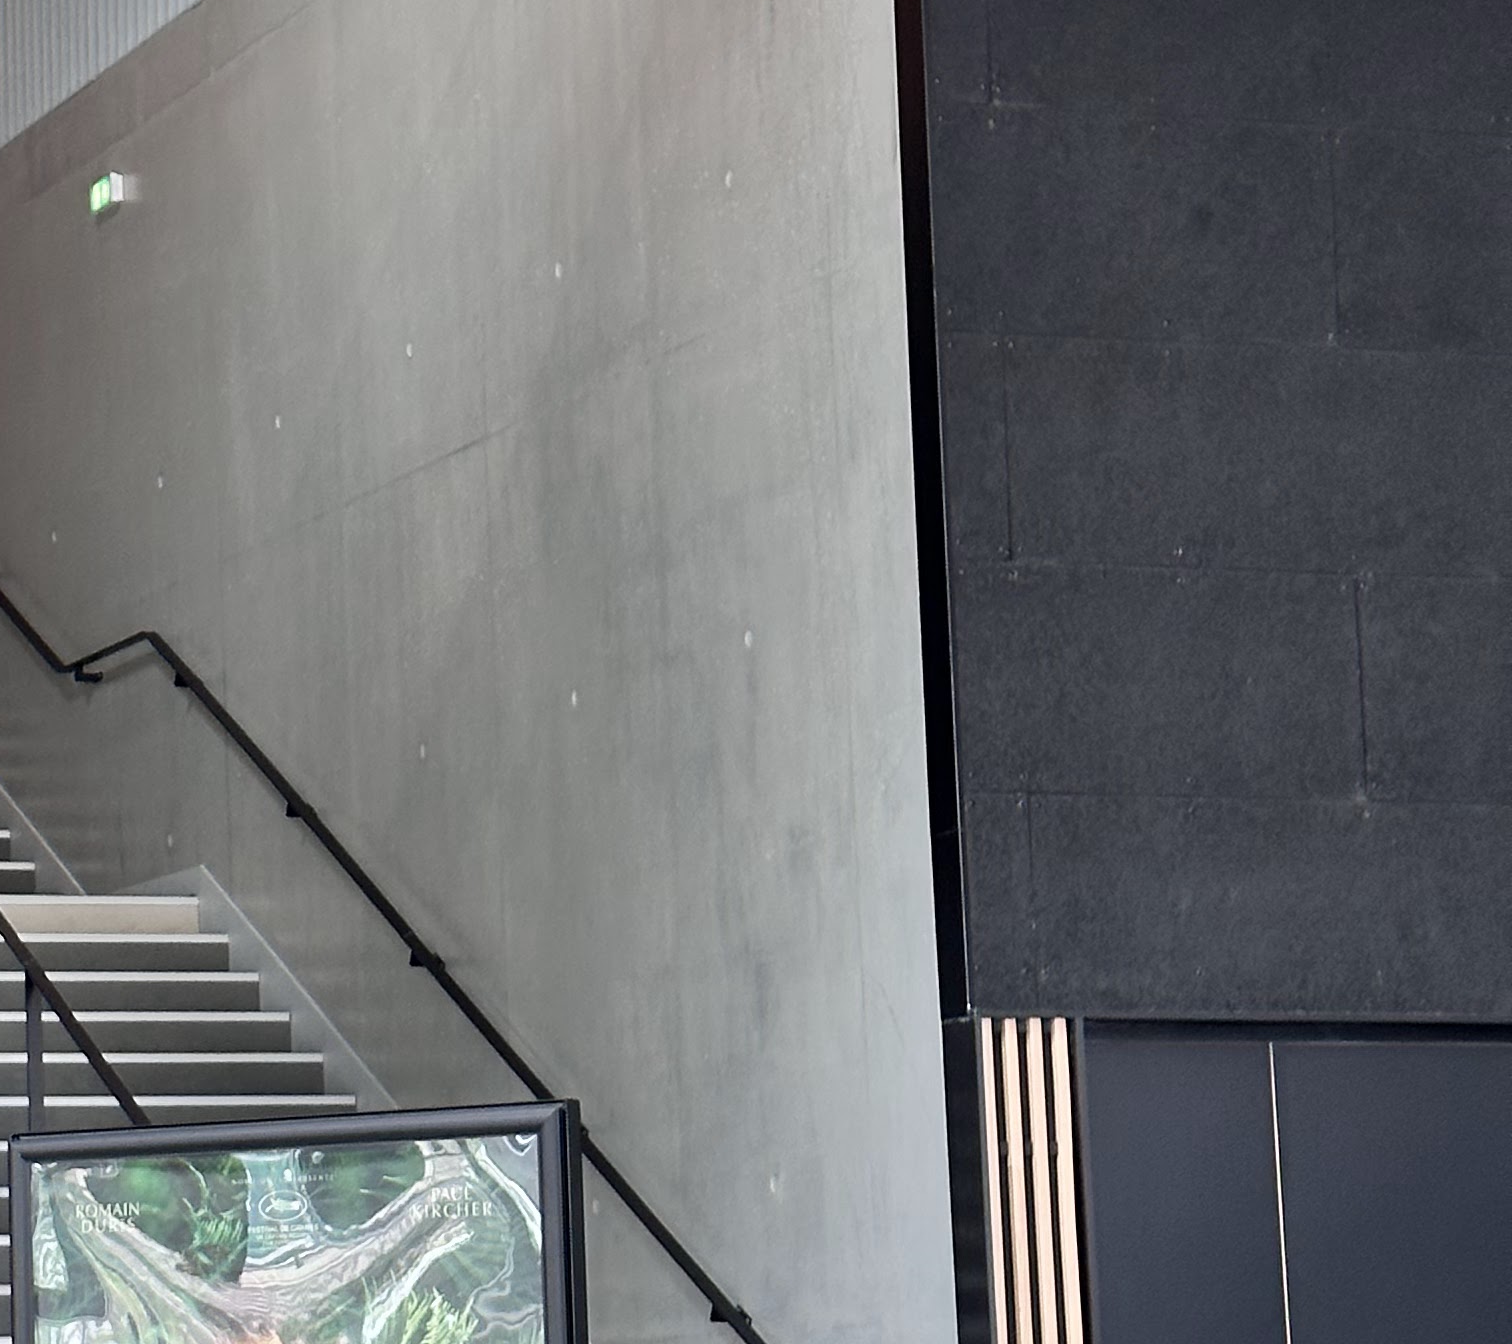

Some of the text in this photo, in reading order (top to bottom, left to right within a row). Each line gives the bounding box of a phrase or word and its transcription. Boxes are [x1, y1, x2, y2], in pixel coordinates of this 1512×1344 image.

[431, 1186, 473, 1202] PAUL
[76, 1202, 140, 1218] ROMAIN
[412, 1201, 493, 1218] KIRCHER
